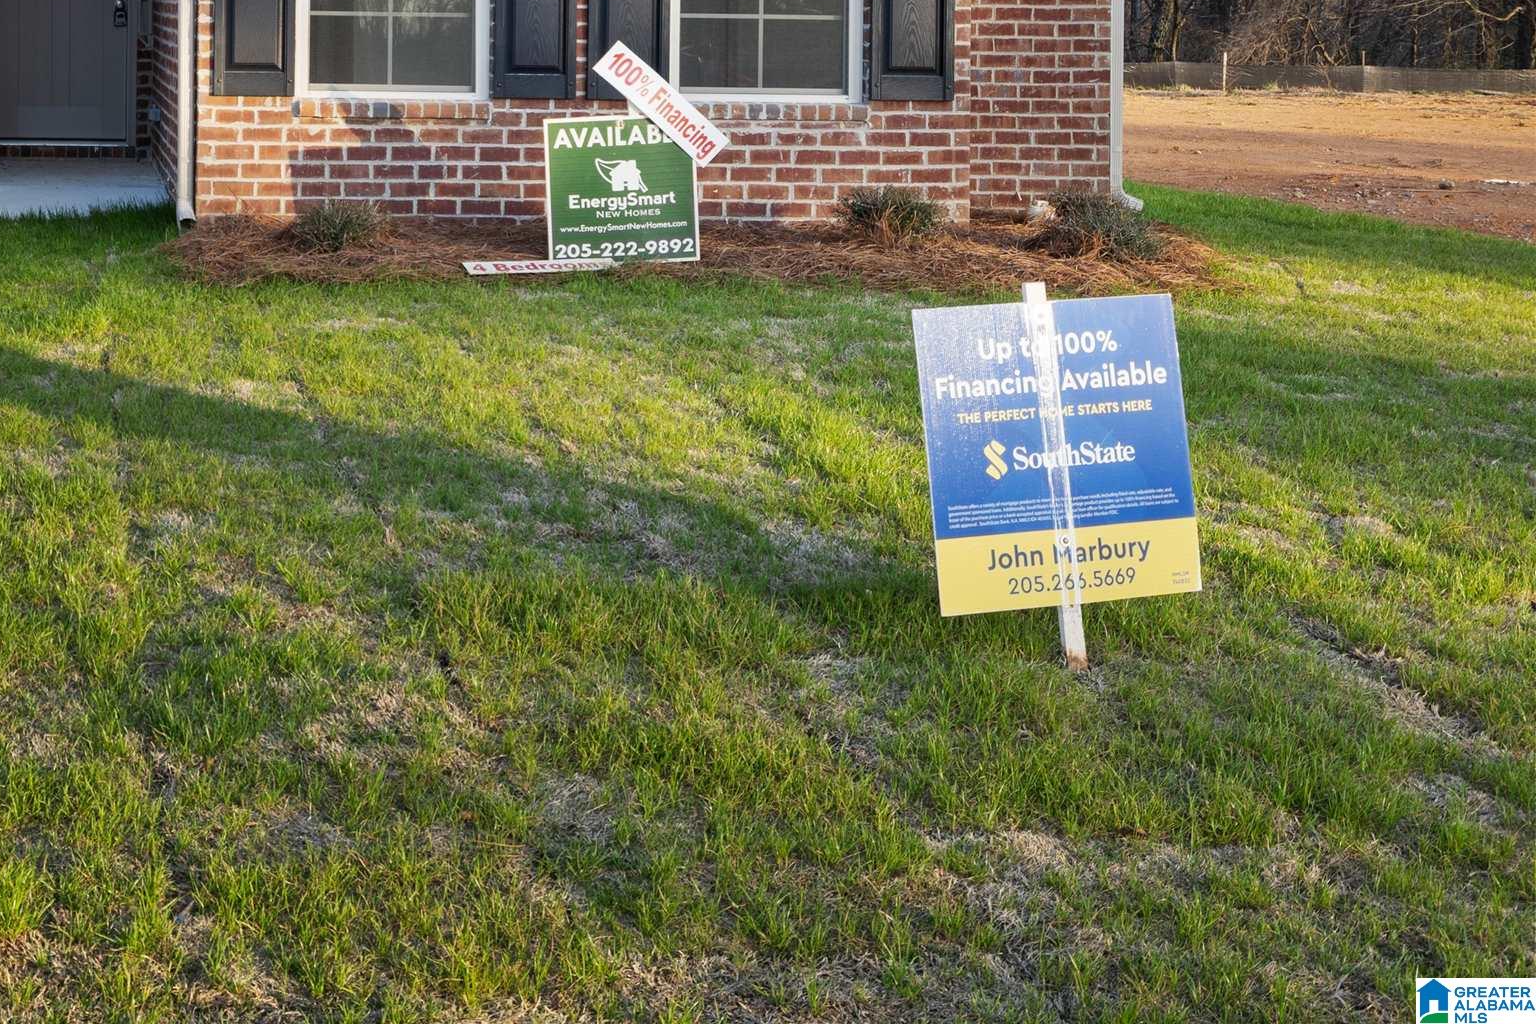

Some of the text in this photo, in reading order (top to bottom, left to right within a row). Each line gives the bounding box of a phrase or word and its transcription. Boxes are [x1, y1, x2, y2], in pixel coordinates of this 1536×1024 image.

[608, 52, 716, 160] 100% Financing
[553, 124, 673, 149] AVAILAB
[568, 191, 676, 210] EnergySmart
[596, 208, 661, 218] NEW HOMES
[560, 221, 687, 233] www.EnergySmartNewHomes.com
[554, 238, 694, 258] 205-222-9892
[472, 263, 486, 272] 4
[977, 336, 1013, 364] Up
[1054, 329, 1118, 356] 100%
[934, 360, 1168, 400] Financing Available
[957, 413, 981, 425] THE
[984, 407, 1036, 423] PERFECT
[1077, 402, 1120, 416] STARTS
[1122, 399, 1153, 413] HERE
[1013, 440, 1136, 471] SouthState
[988, 537, 1151, 571] John Marbury
[1008, 567, 1136, 594] 205.266.5669
